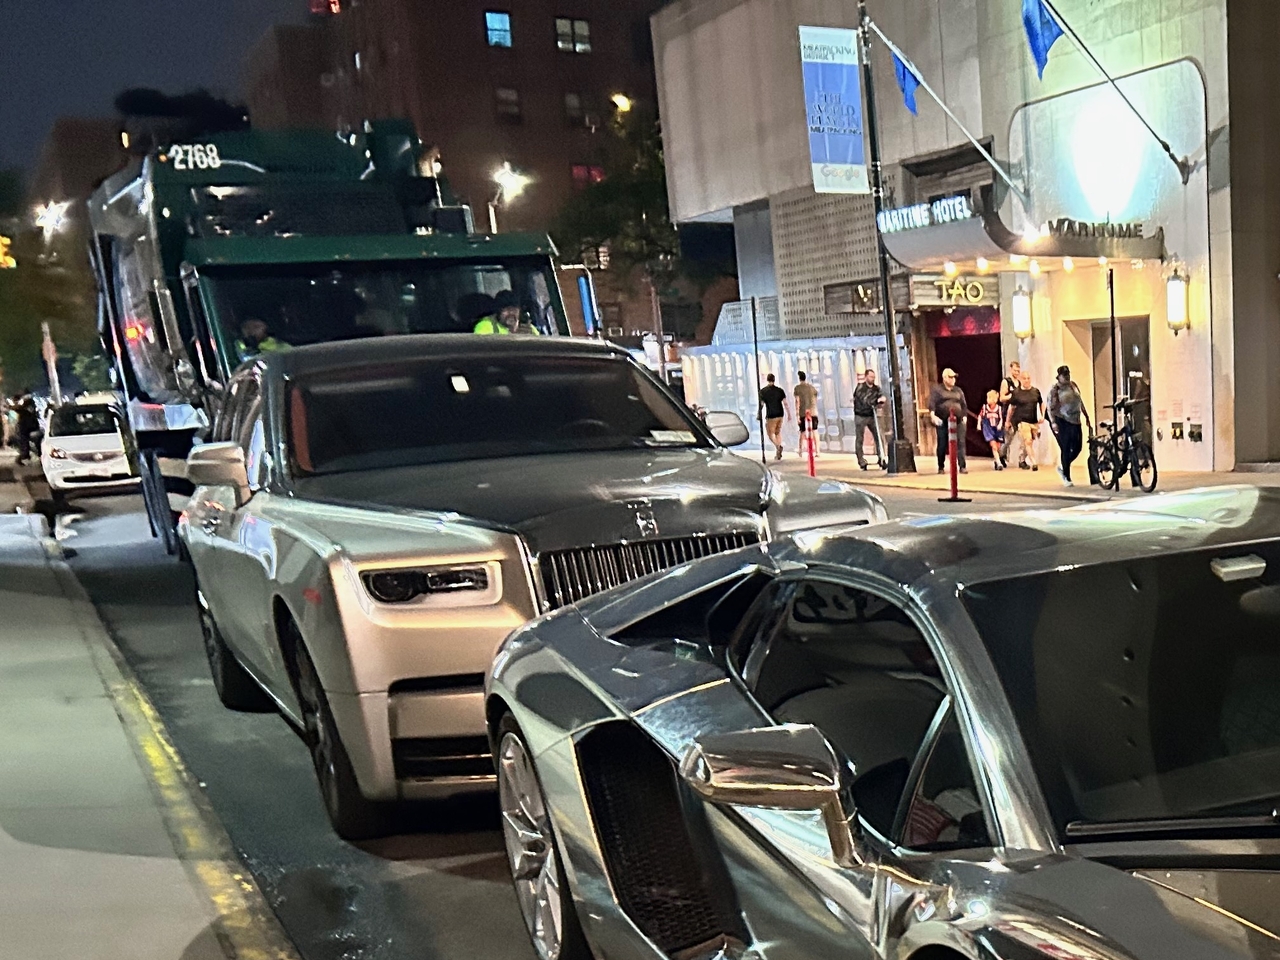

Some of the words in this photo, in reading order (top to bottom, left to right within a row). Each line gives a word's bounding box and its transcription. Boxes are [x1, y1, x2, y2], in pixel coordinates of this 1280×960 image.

[810, 126, 862, 135] MEATPACKING
[173, 144, 221, 169] 2768
[820, 164, 860, 181] Google
[877, 203, 930, 233] MARITIME
[932, 195, 972, 223] HOTEL
[1047, 218, 1144, 239] MARITIME
[933, 279, 984, 304] TAO
